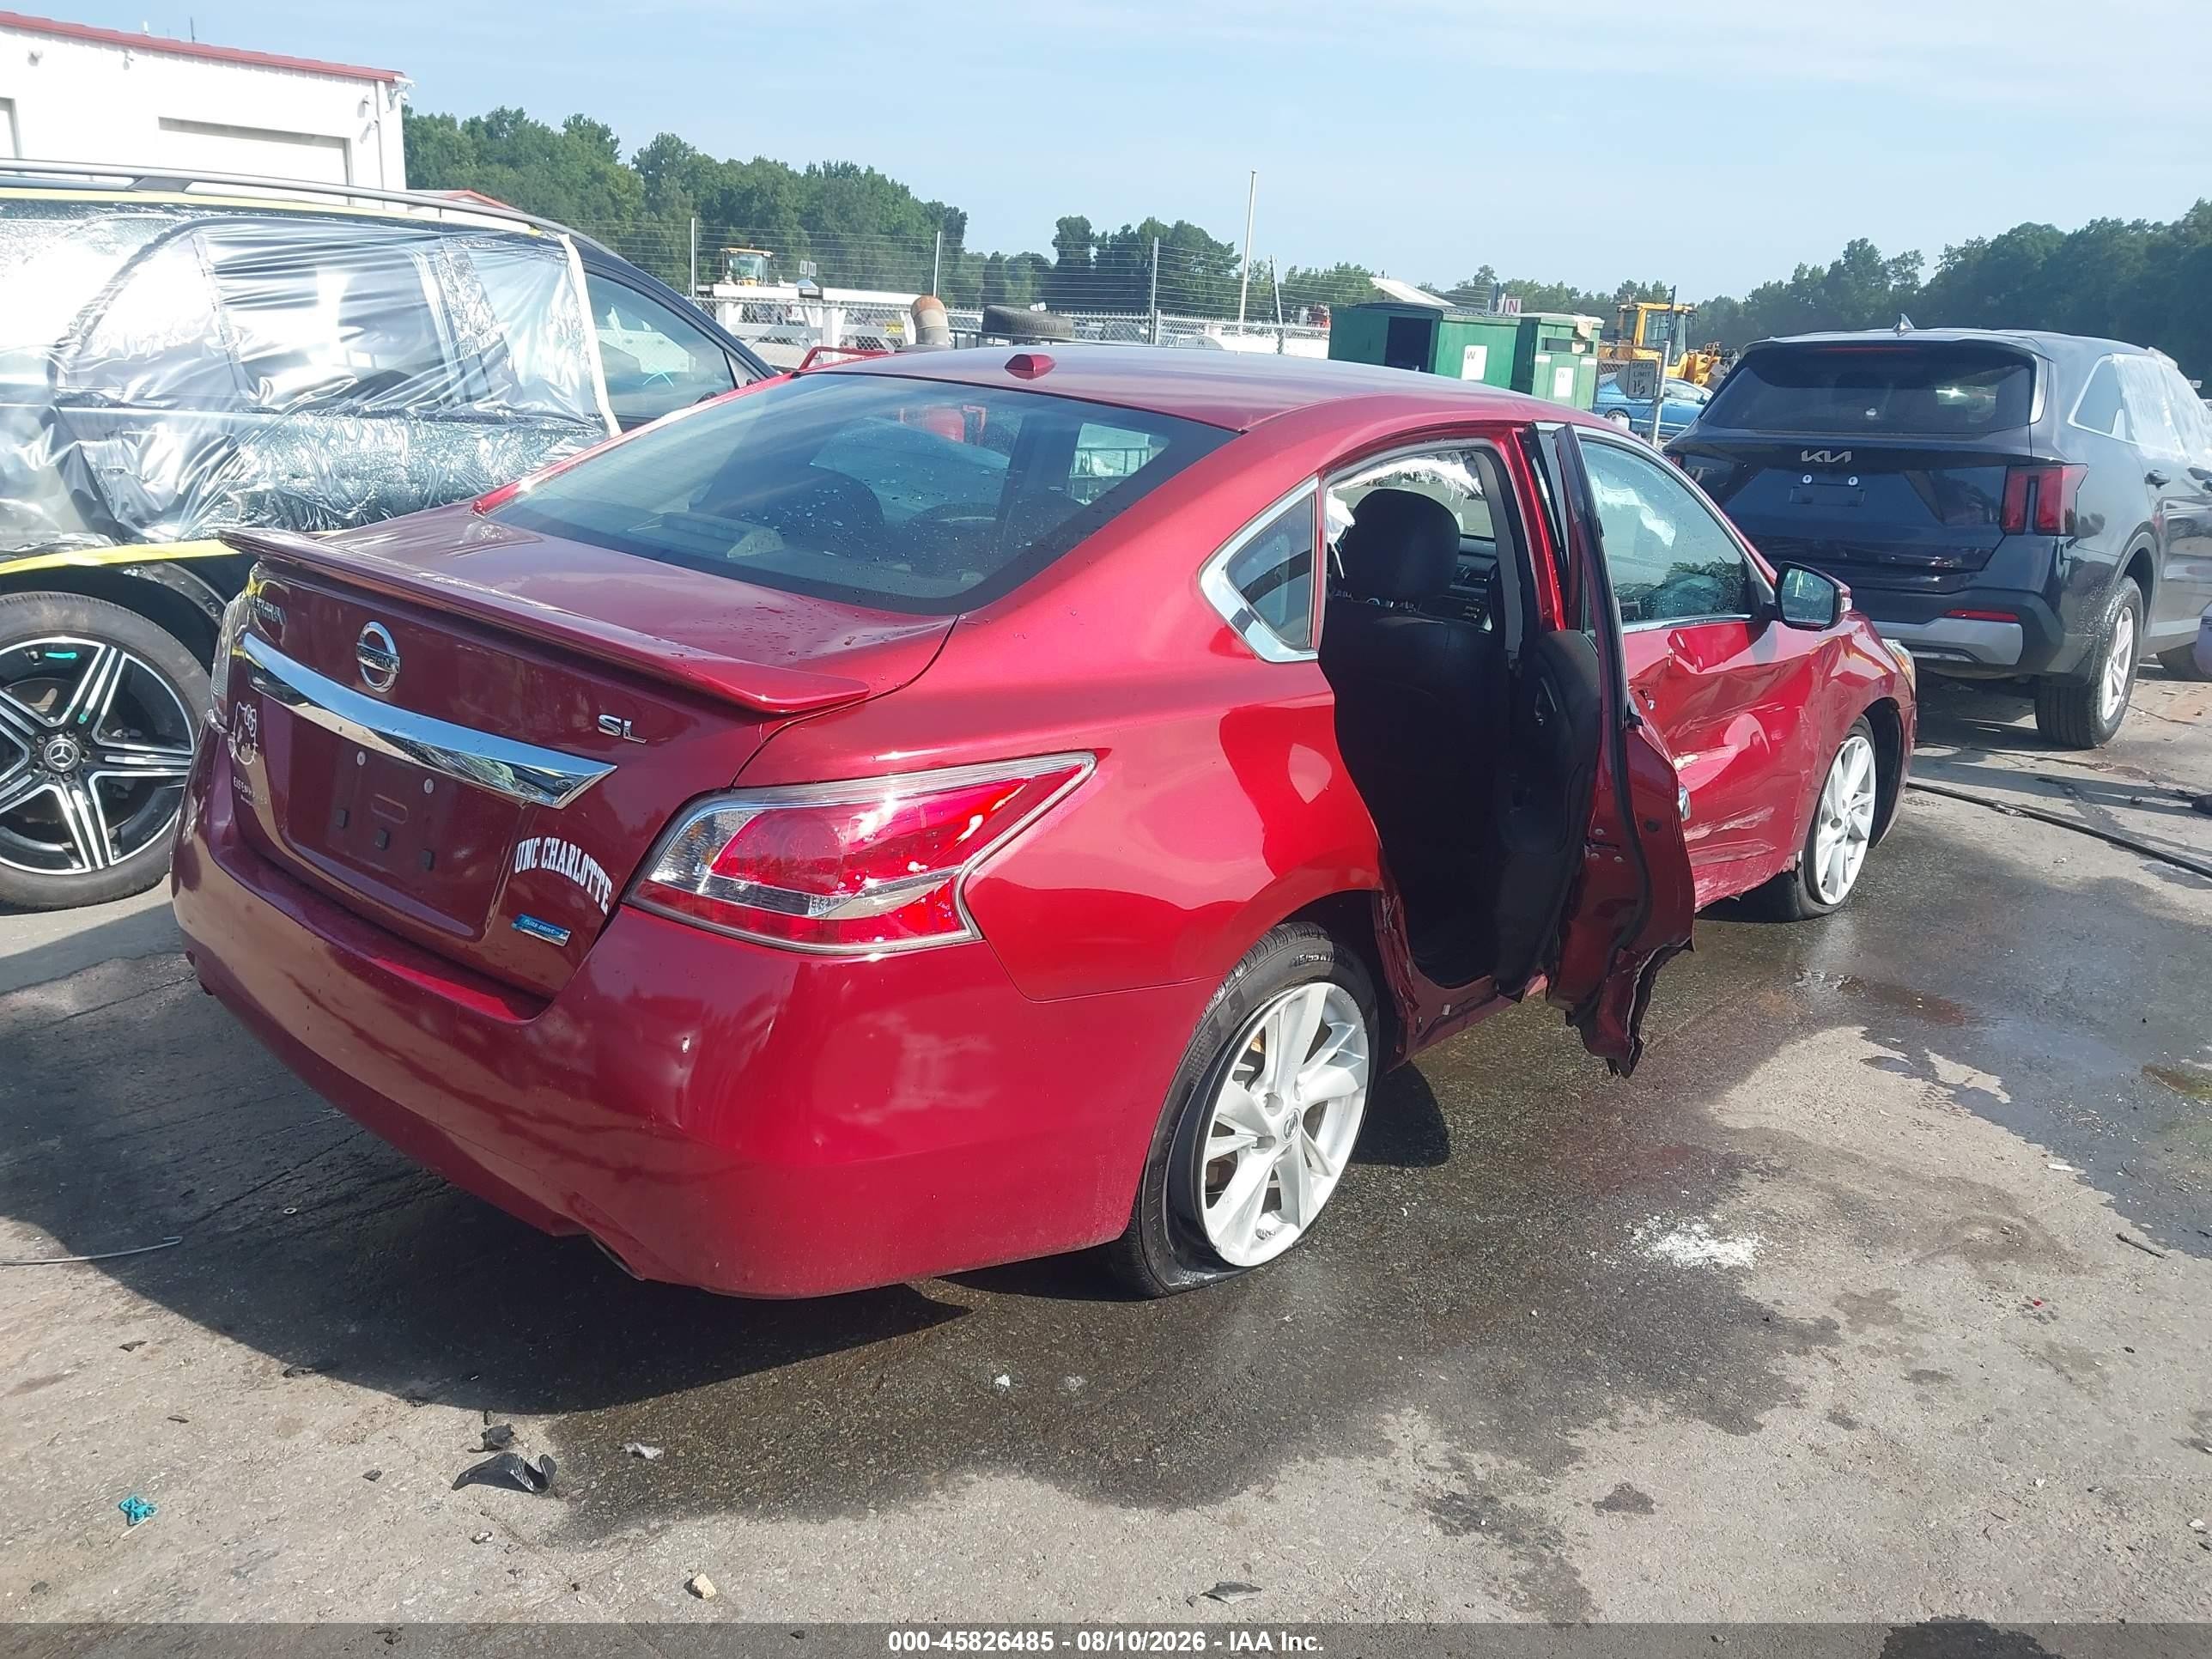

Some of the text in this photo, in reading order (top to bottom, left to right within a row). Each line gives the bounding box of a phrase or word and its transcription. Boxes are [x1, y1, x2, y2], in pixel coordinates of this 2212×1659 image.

[1801, 449, 1852, 463] KIA
[598, 714, 647, 744] SL
[515, 837, 612, 915] UNC CHARLOTTE
